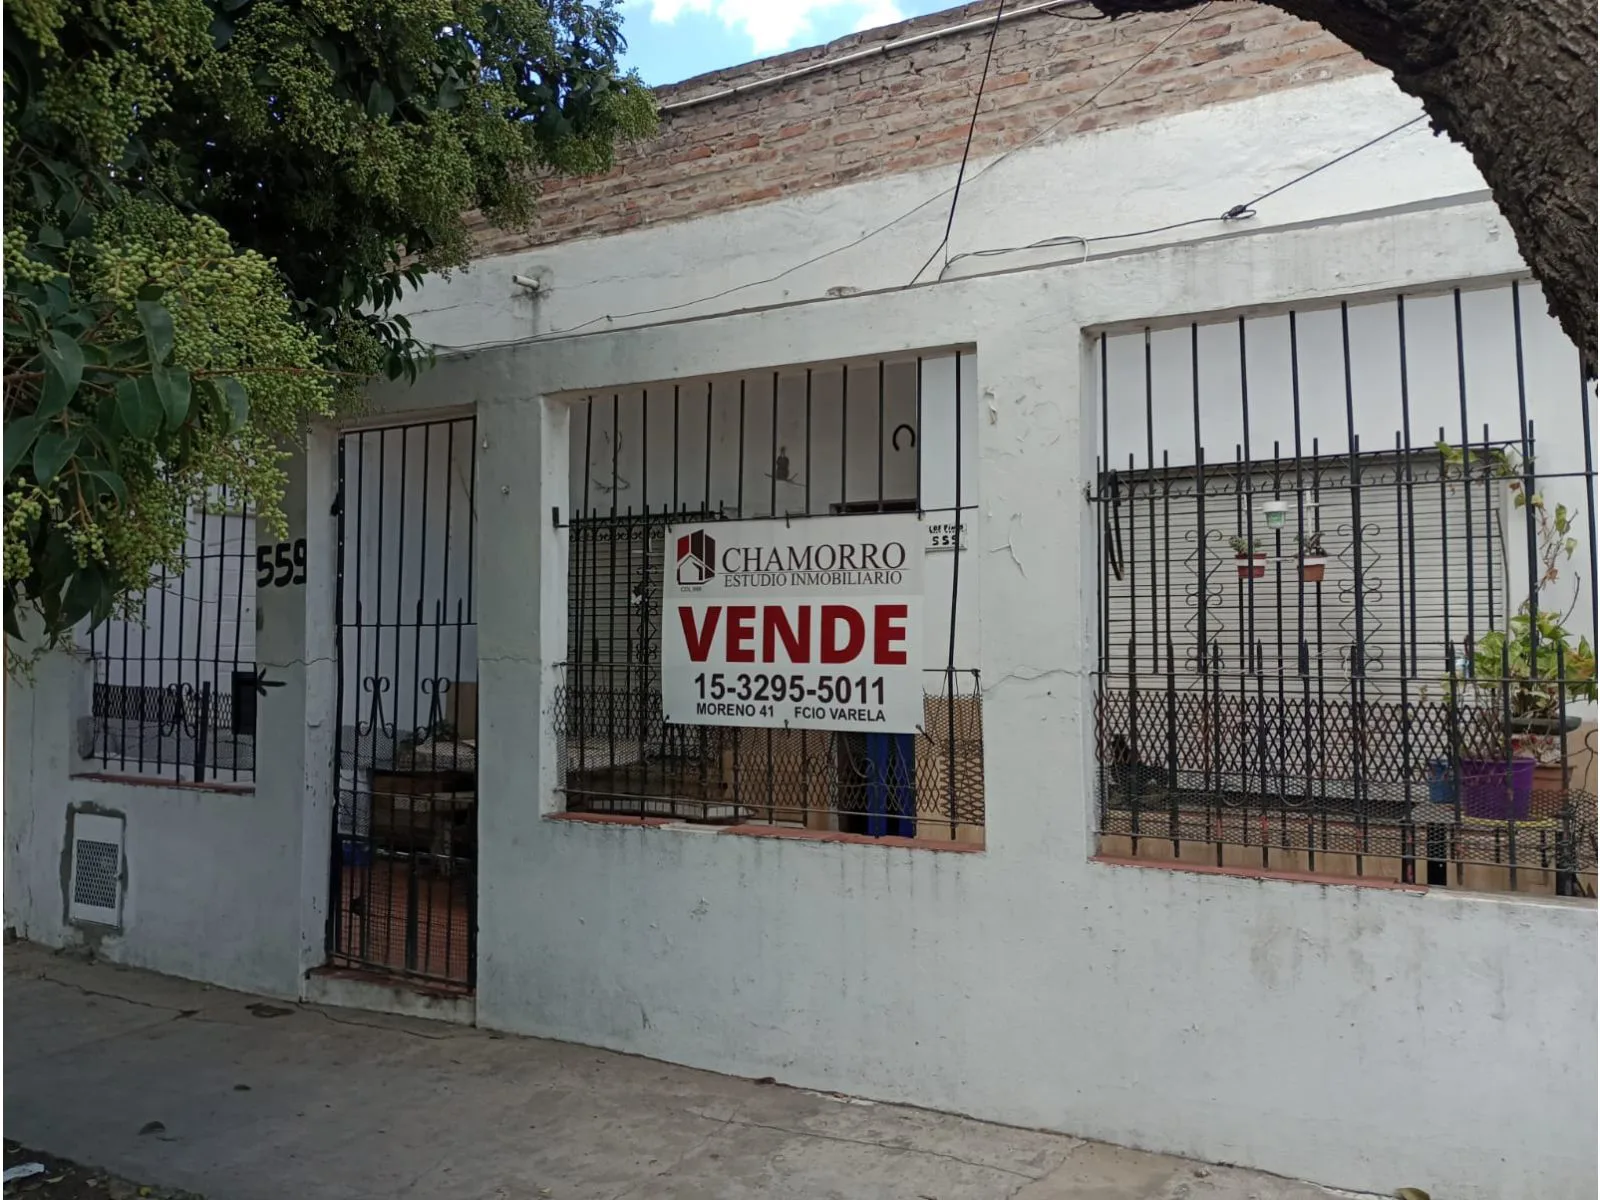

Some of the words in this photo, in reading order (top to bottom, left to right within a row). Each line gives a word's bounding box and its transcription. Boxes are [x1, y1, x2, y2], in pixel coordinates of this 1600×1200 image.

[257, 538, 307, 588] 559
[722, 542, 906, 573] CHAMORRO
[725, 573, 787, 588] ESTUDIO
[791, 571, 902, 586] INMOBILIARIO
[678, 604, 908, 665] VENDE
[694, 672, 884, 705] 15-3295-5011
[697, 703, 755, 717] MORENO
[760, 705, 774, 717] 41
[794, 706, 826, 719] FCIO
[829, 708, 886, 722] VARELA
